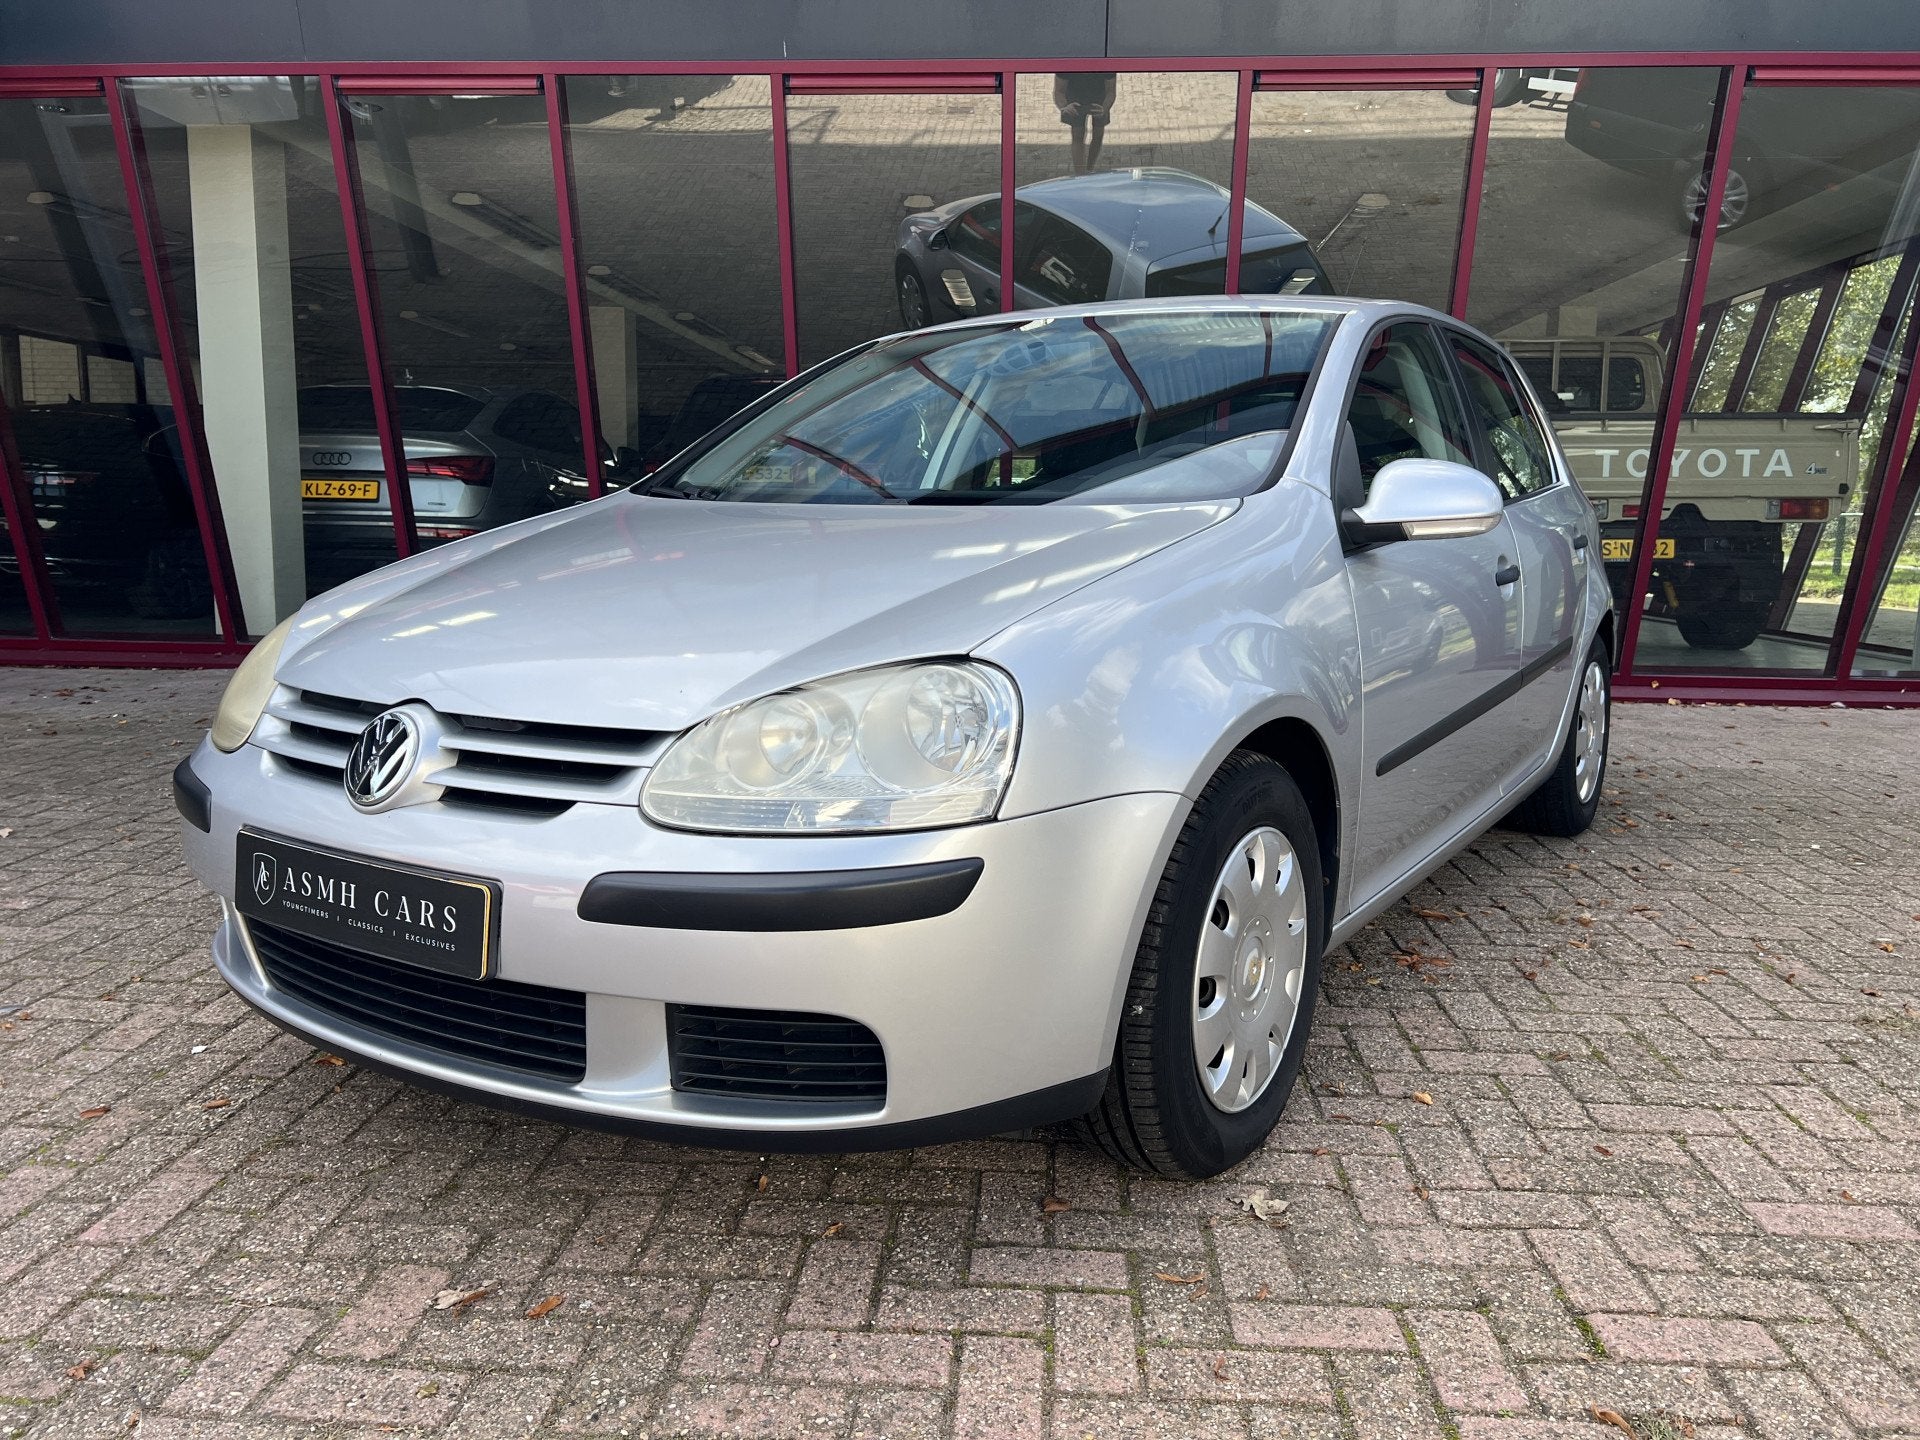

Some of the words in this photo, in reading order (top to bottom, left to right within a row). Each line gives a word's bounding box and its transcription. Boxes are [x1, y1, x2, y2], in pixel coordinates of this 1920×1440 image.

[1595, 449, 1793, 478] TOYOTA
[304, 483, 372, 497] KLZ-69-F
[283, 867, 357, 909] ASMH
[374, 890, 457, 933] CARS
[282, 900, 329, 919] YOUNGTIMERS
[348, 918, 384, 934] CLASSICS
[405, 933, 456, 952] EXCLUSIVES
